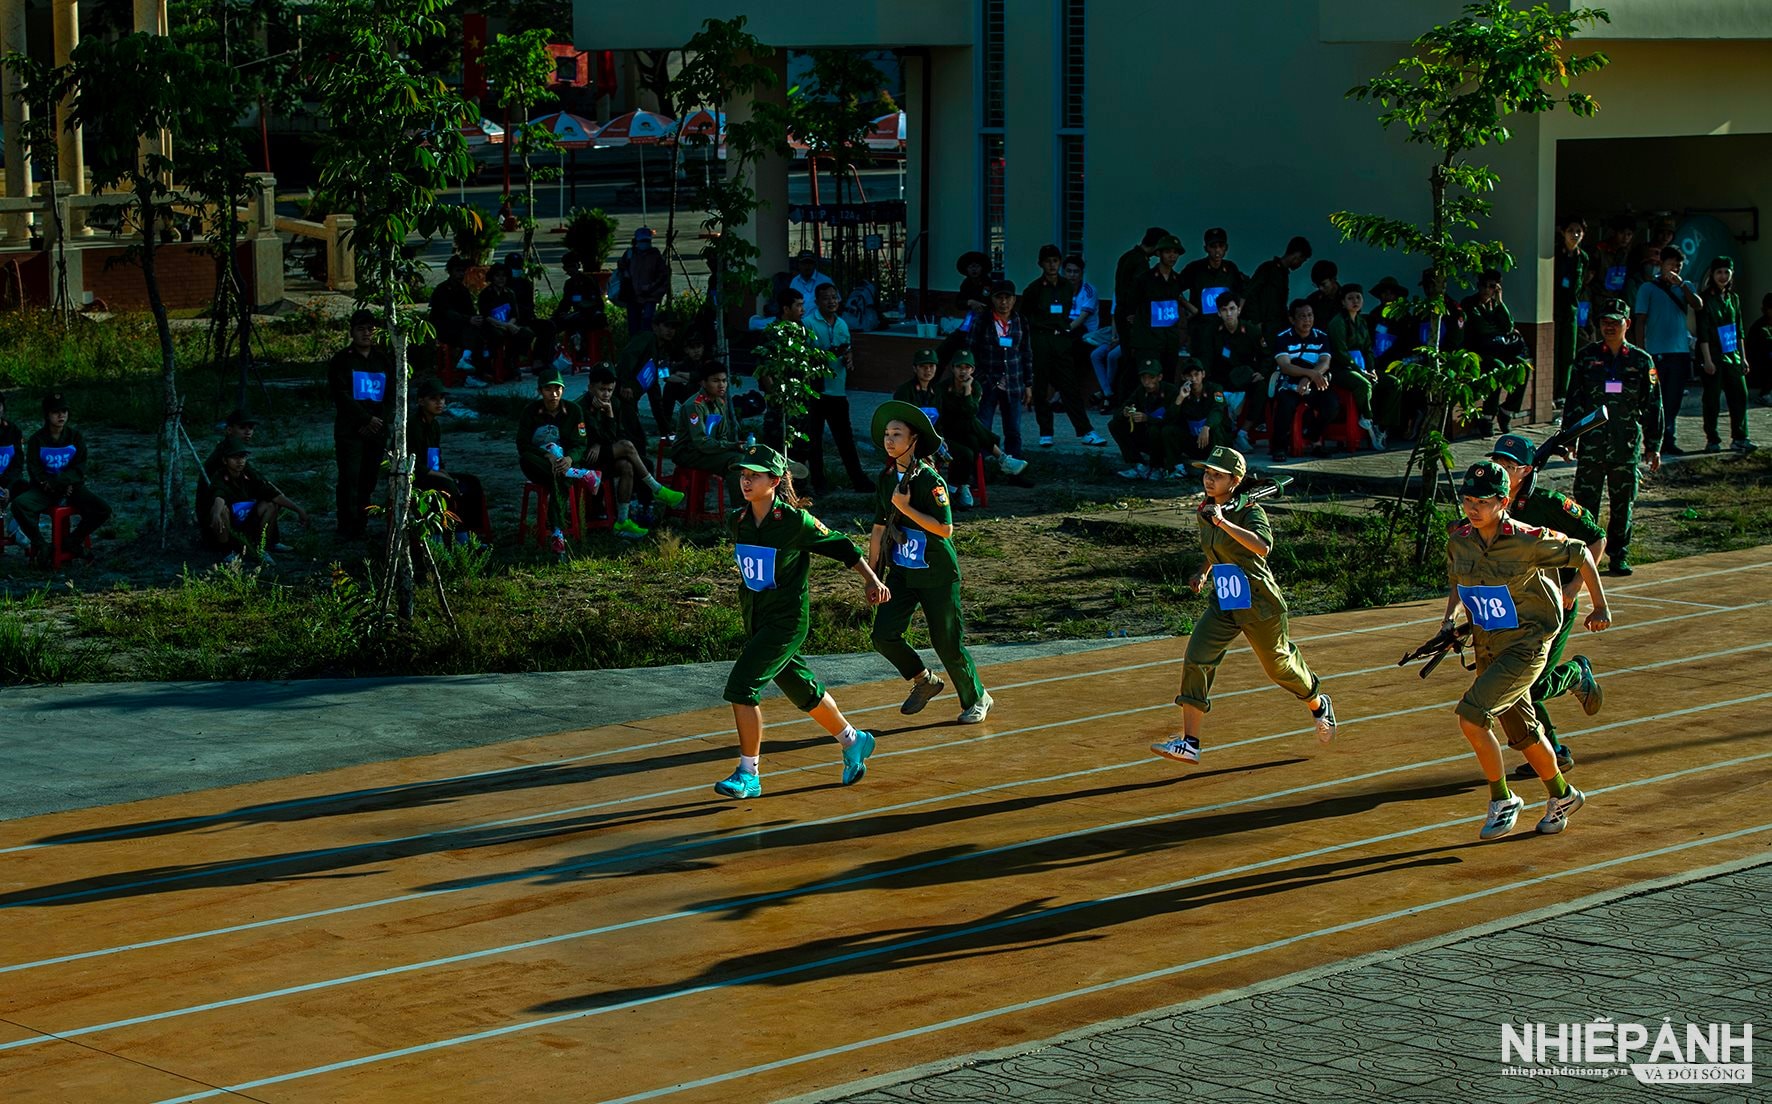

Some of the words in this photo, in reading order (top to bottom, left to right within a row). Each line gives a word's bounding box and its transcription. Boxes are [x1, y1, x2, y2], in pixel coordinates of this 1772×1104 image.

[360, 378, 381, 394] 122
[46, 453, 70, 469] 235
[737, 554, 765, 582] 81
